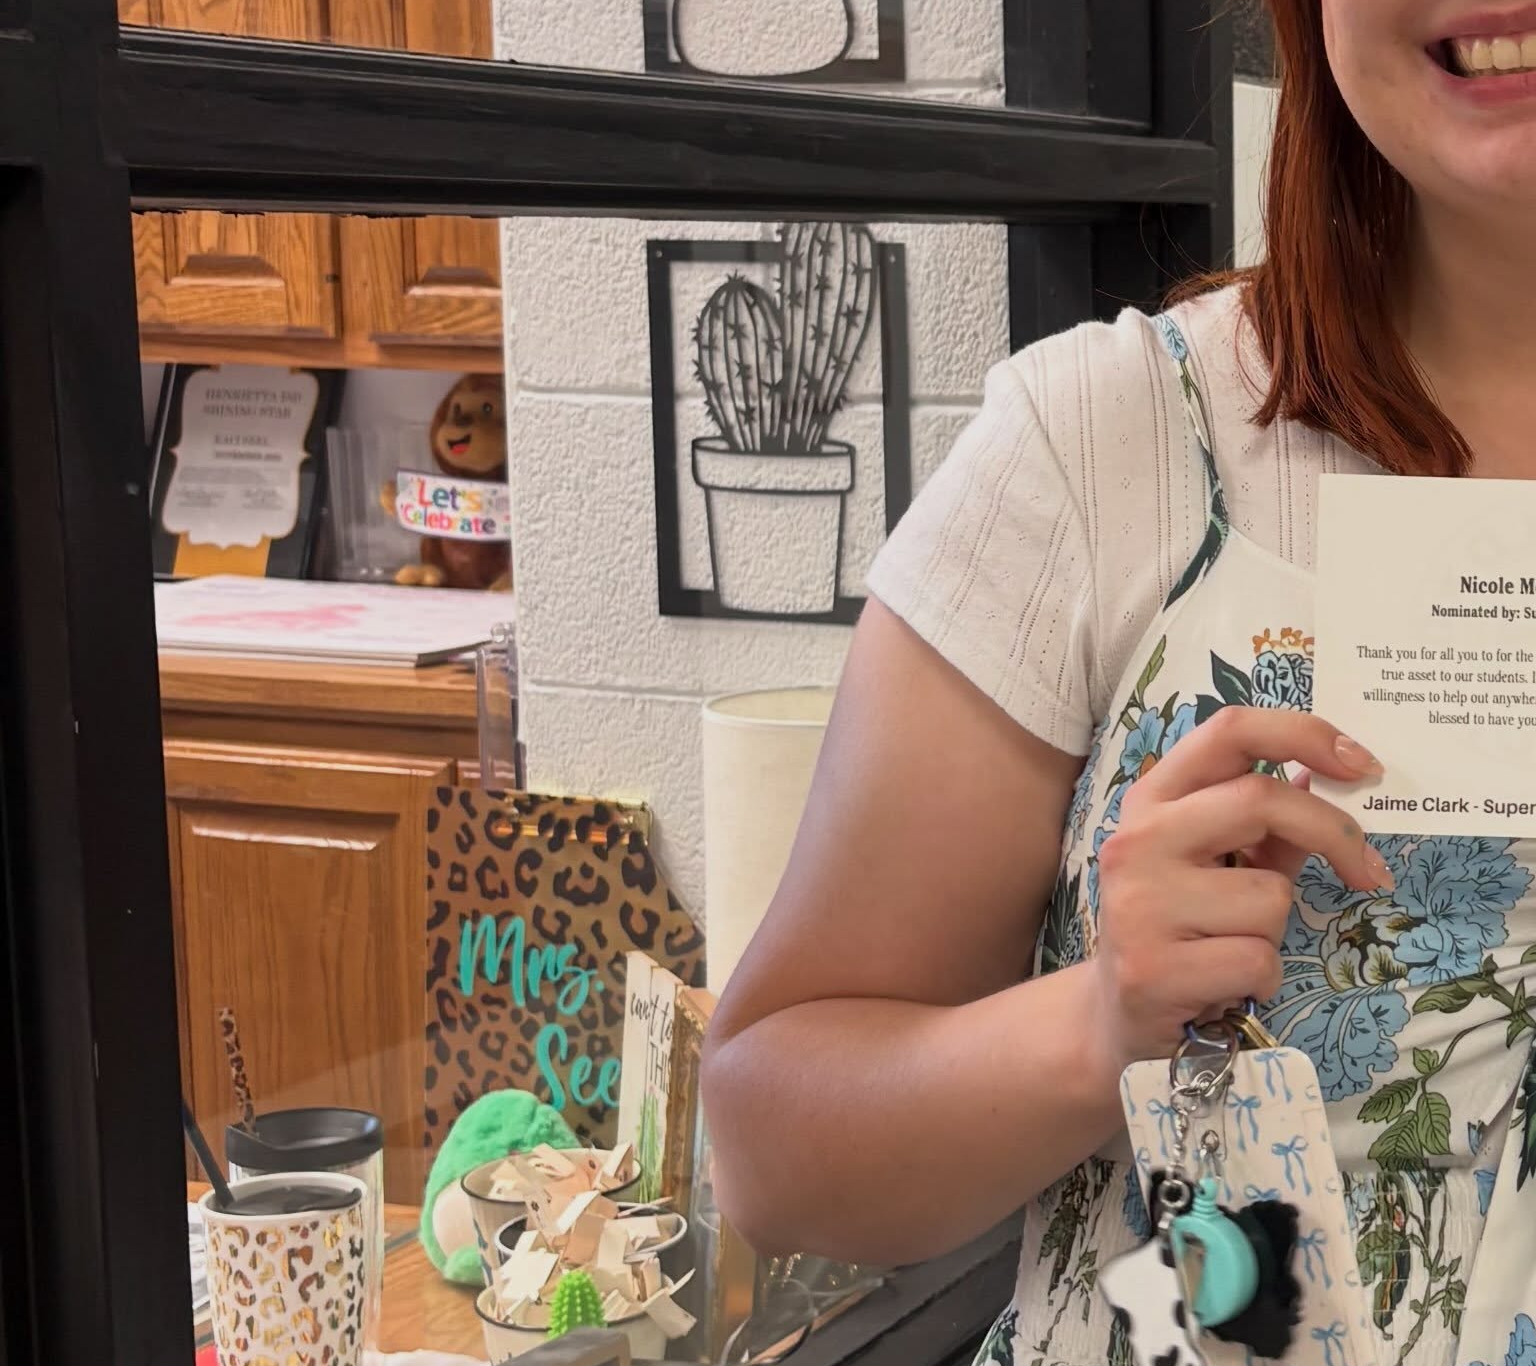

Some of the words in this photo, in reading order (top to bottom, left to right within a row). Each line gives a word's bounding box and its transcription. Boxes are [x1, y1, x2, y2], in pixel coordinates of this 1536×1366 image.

[417, 477, 483, 512] Let's
[1460, 576, 1514, 594] Nicole
[1432, 605, 1497, 618] Nominated
[1502, 606, 1520, 622] by:
[1356, 646, 1392, 659] Thank
[1396, 650, 1416, 662] you
[1421, 647, 1437, 660] for
[1440, 648, 1454, 660] all
[1457, 651, 1478, 664] you
[1482, 651, 1493, 661] to
[1496, 649, 1512, 662] for
[1516, 649, 1533, 662] the
[1382, 669, 1404, 680] true
[1408, 670, 1436, 681] asset
[1440, 671, 1451, 682] to
[1455, 673, 1473, 682] our
[1477, 670, 1528, 683] students.
[1532, 671, 1536, 683] I
[1363, 688, 1425, 705] willingness
[1429, 692, 1440, 702] to
[1443, 690, 1467, 706] help
[1471, 693, 1488, 703] out
[1429, 711, 1469, 724] blessed
[1474, 714, 1484, 724] to
[1488, 712, 1514, 725] have
[1363, 796, 1417, 811] Jaime
[1422, 797, 1469, 812] Clark
[460, 915, 604, 1016] Mrs.
